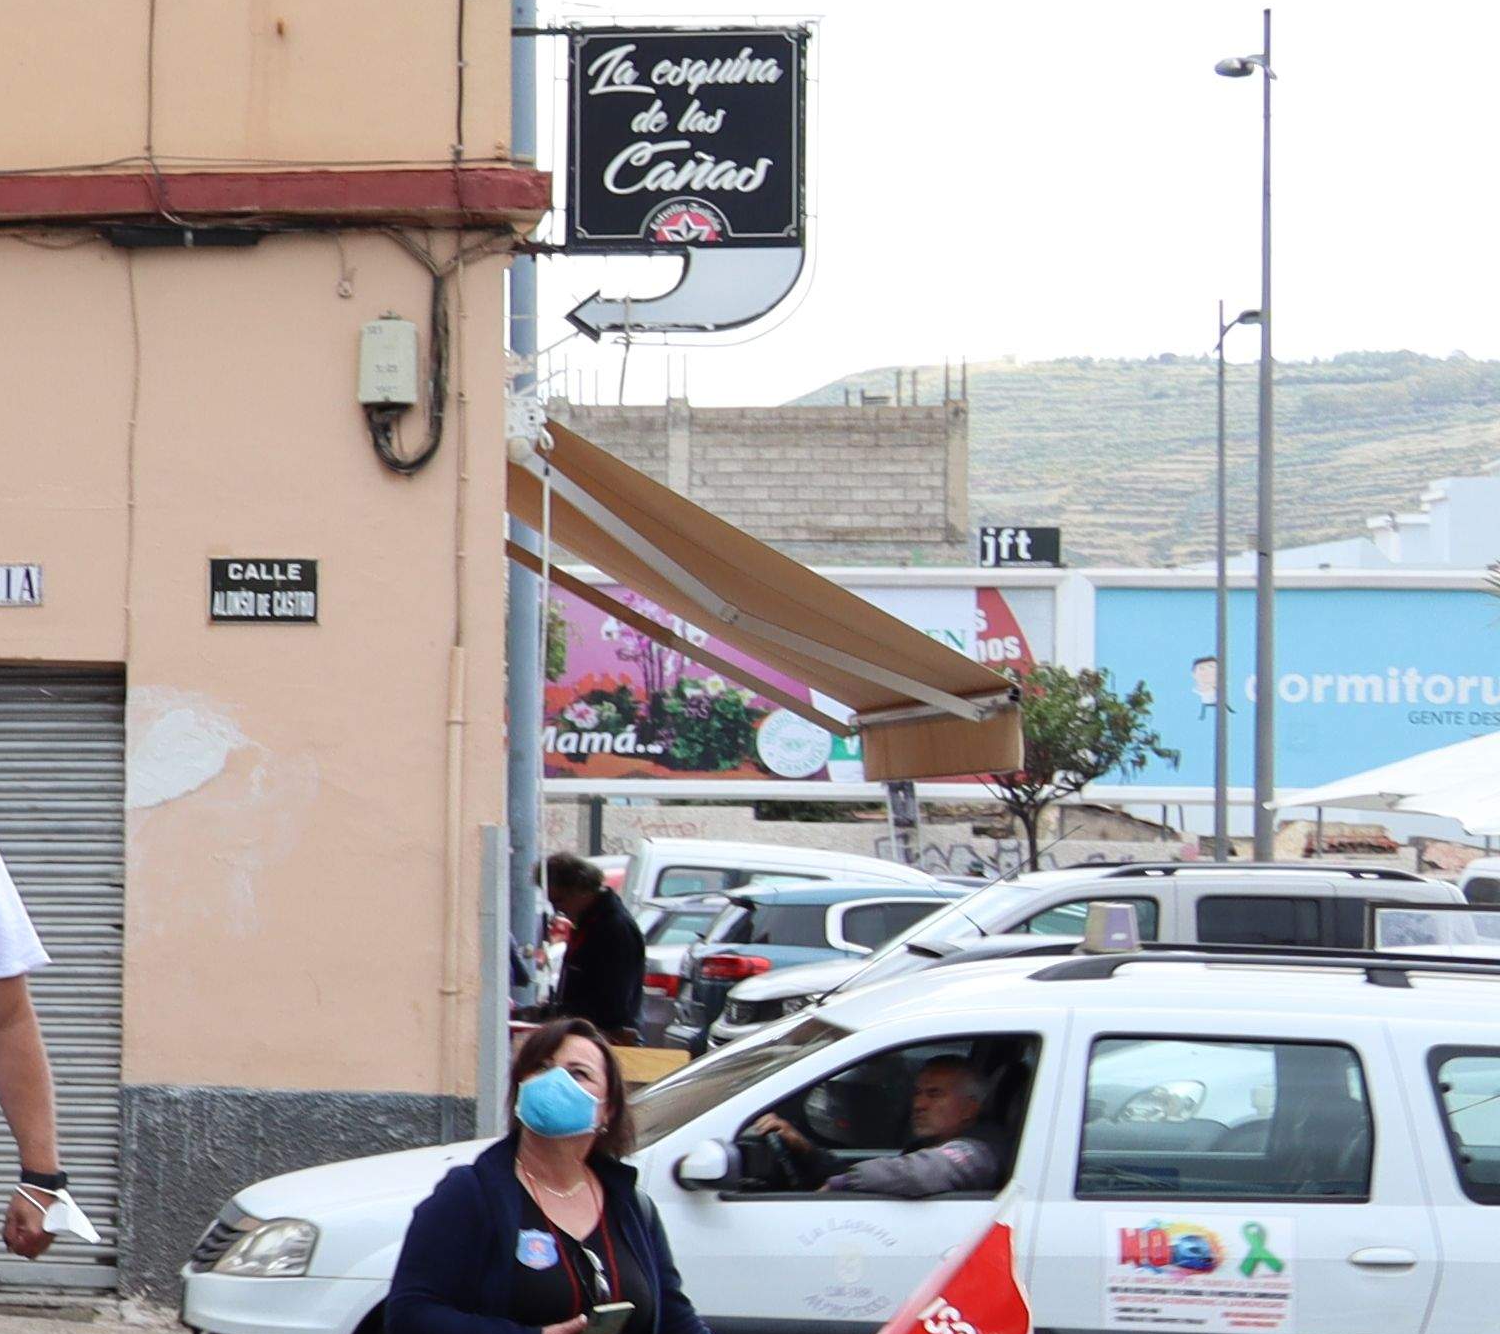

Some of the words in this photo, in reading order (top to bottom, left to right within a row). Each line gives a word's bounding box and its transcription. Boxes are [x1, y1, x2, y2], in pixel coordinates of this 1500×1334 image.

[587, 43, 656, 95] La
[651, 47, 784, 95] esquina
[631, 99, 669, 133] de
[677, 99, 727, 133] las
[603, 140, 774, 195] Cañas
[982, 527, 1032, 567] jft
[227, 562, 302, 581] CALLE
[256, 593, 272, 616] DE
[1408, 710, 1465, 725] GENTE
